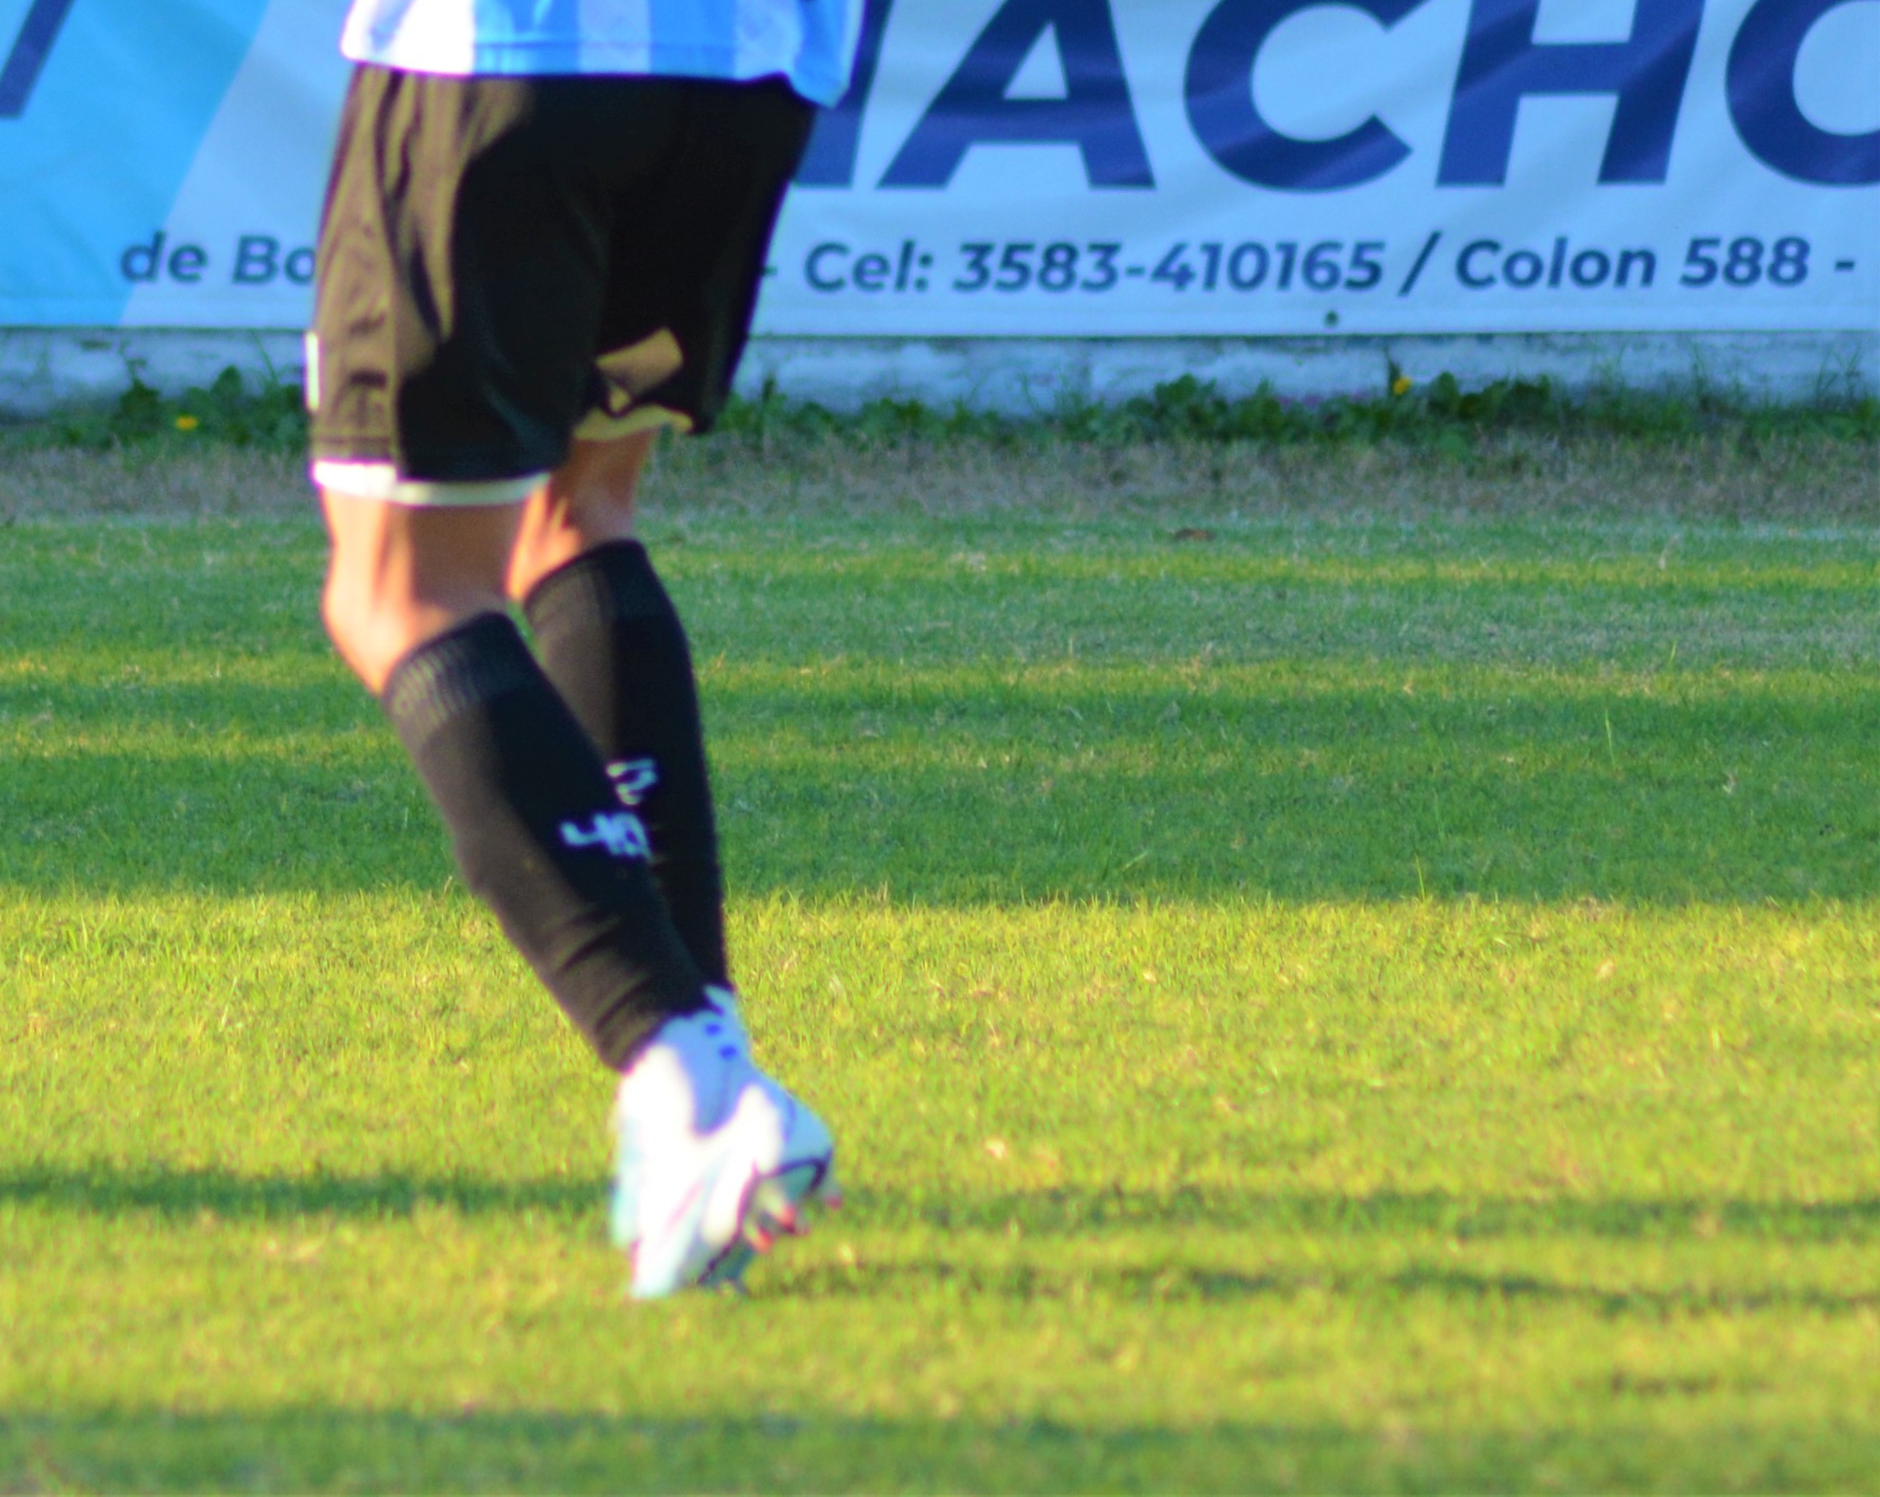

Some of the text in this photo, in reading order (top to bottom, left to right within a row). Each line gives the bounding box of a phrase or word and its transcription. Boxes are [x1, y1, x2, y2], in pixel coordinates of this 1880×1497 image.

[120, 232, 209, 286] de
[803, 240, 932, 294] Cel:
[952, 240, 1386, 294] 3583-410165
[1454, 237, 1657, 290] Colon
[1679, 236, 1811, 289] 588
